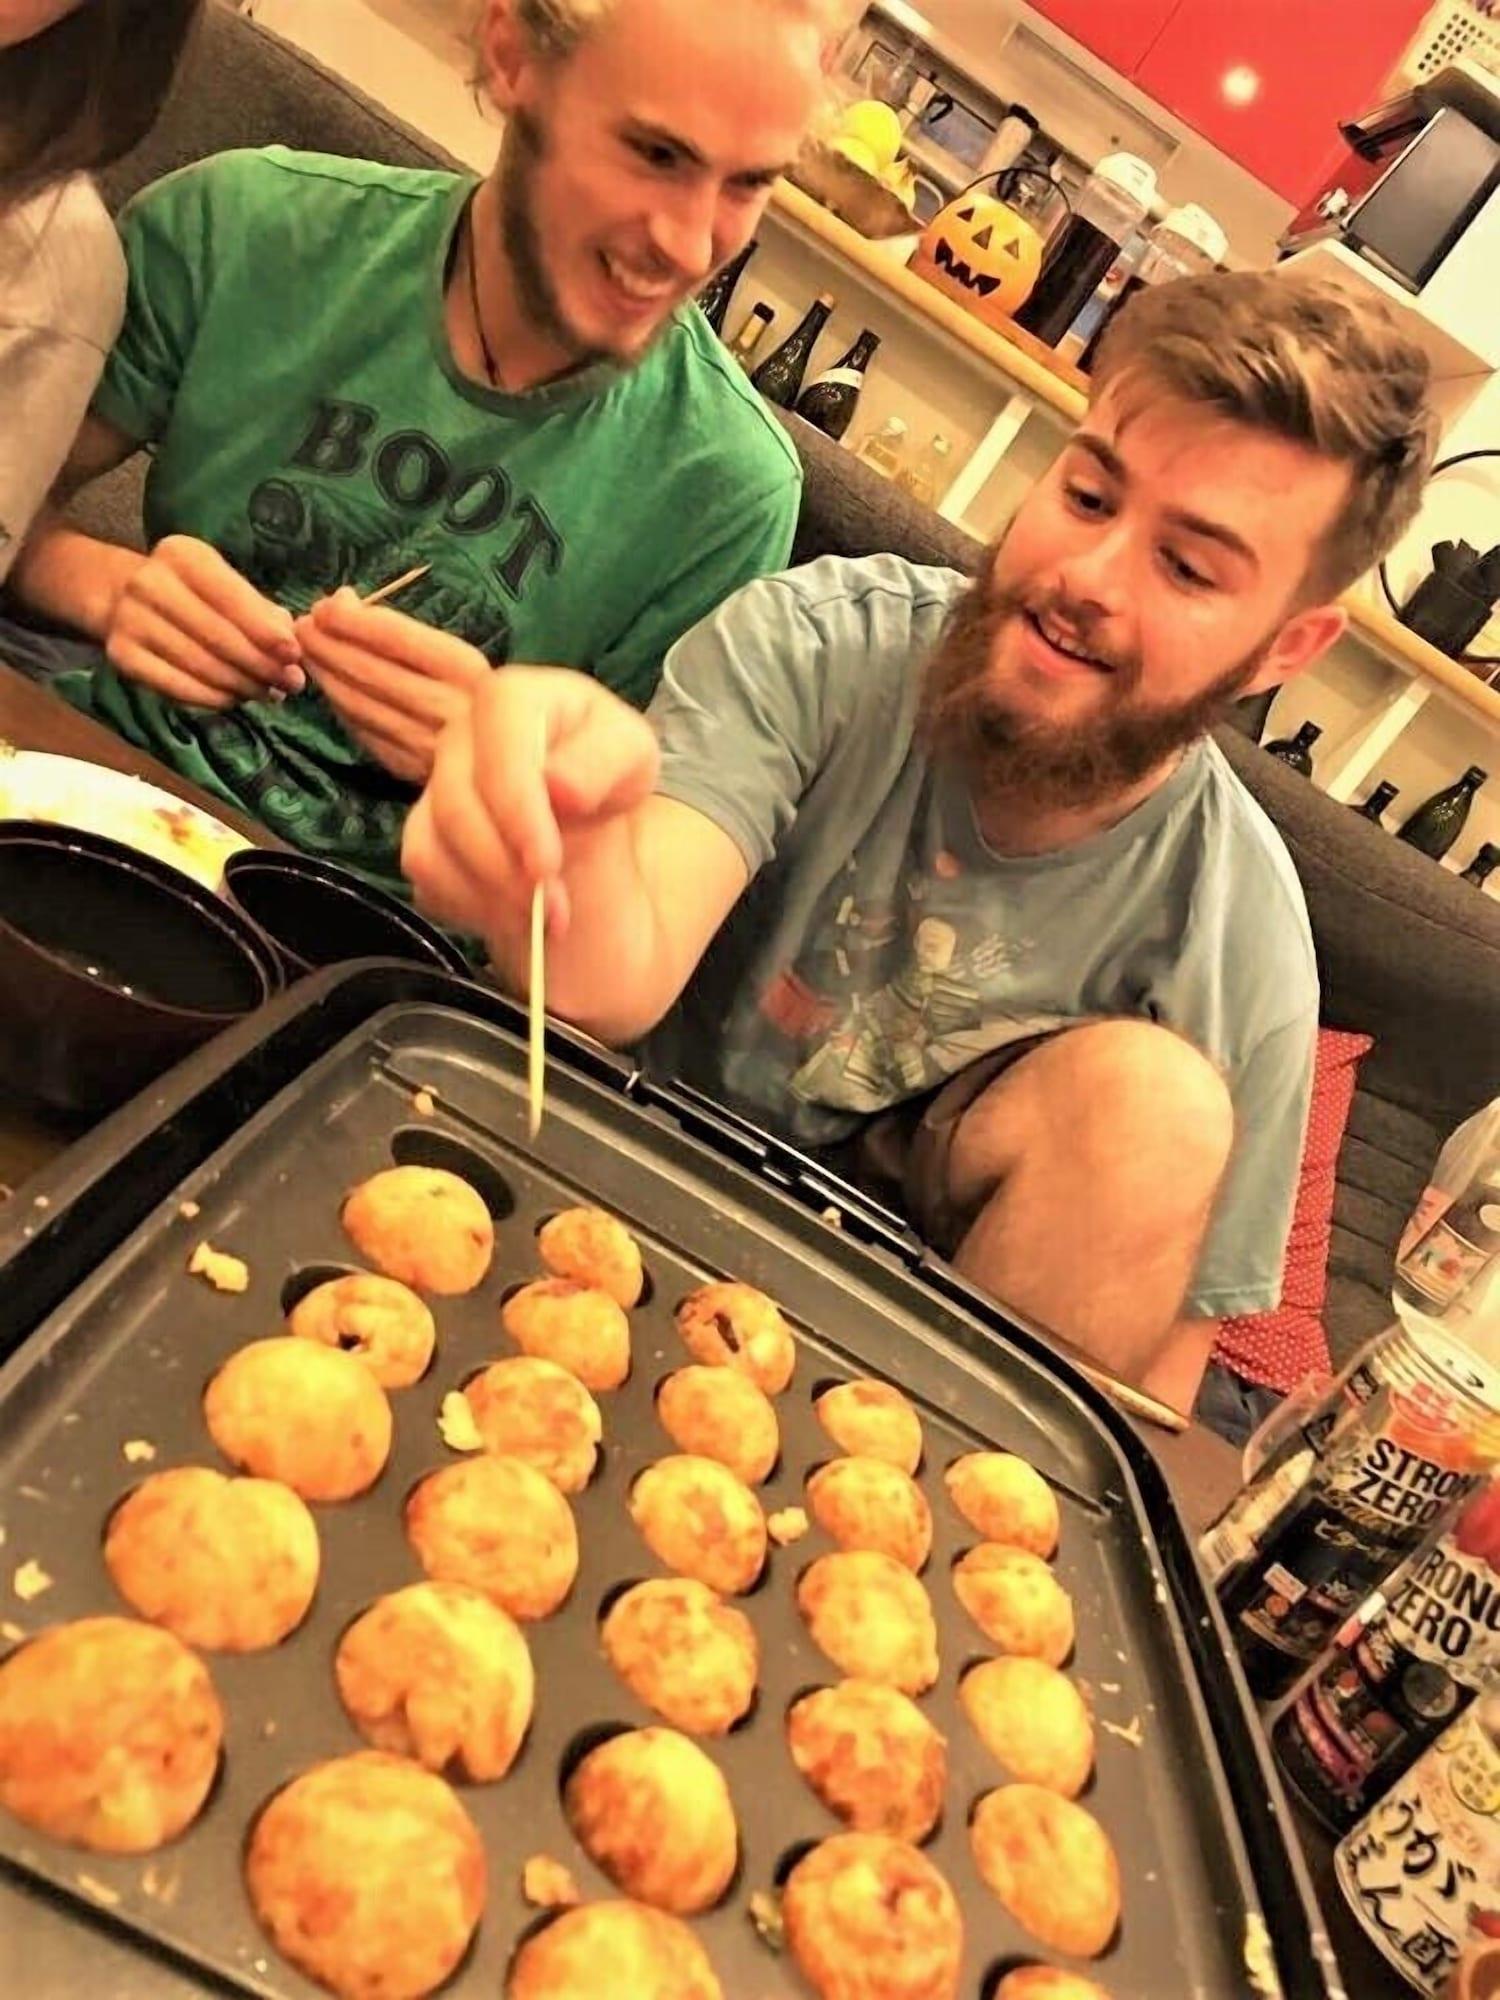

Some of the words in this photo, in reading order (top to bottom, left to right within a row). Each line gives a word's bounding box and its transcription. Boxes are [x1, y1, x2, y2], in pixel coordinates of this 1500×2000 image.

[290, 402, 566, 600] BOOT
[1350, 1467, 1441, 1525] ZERO
[1387, 1578, 1472, 1657] ZERO
